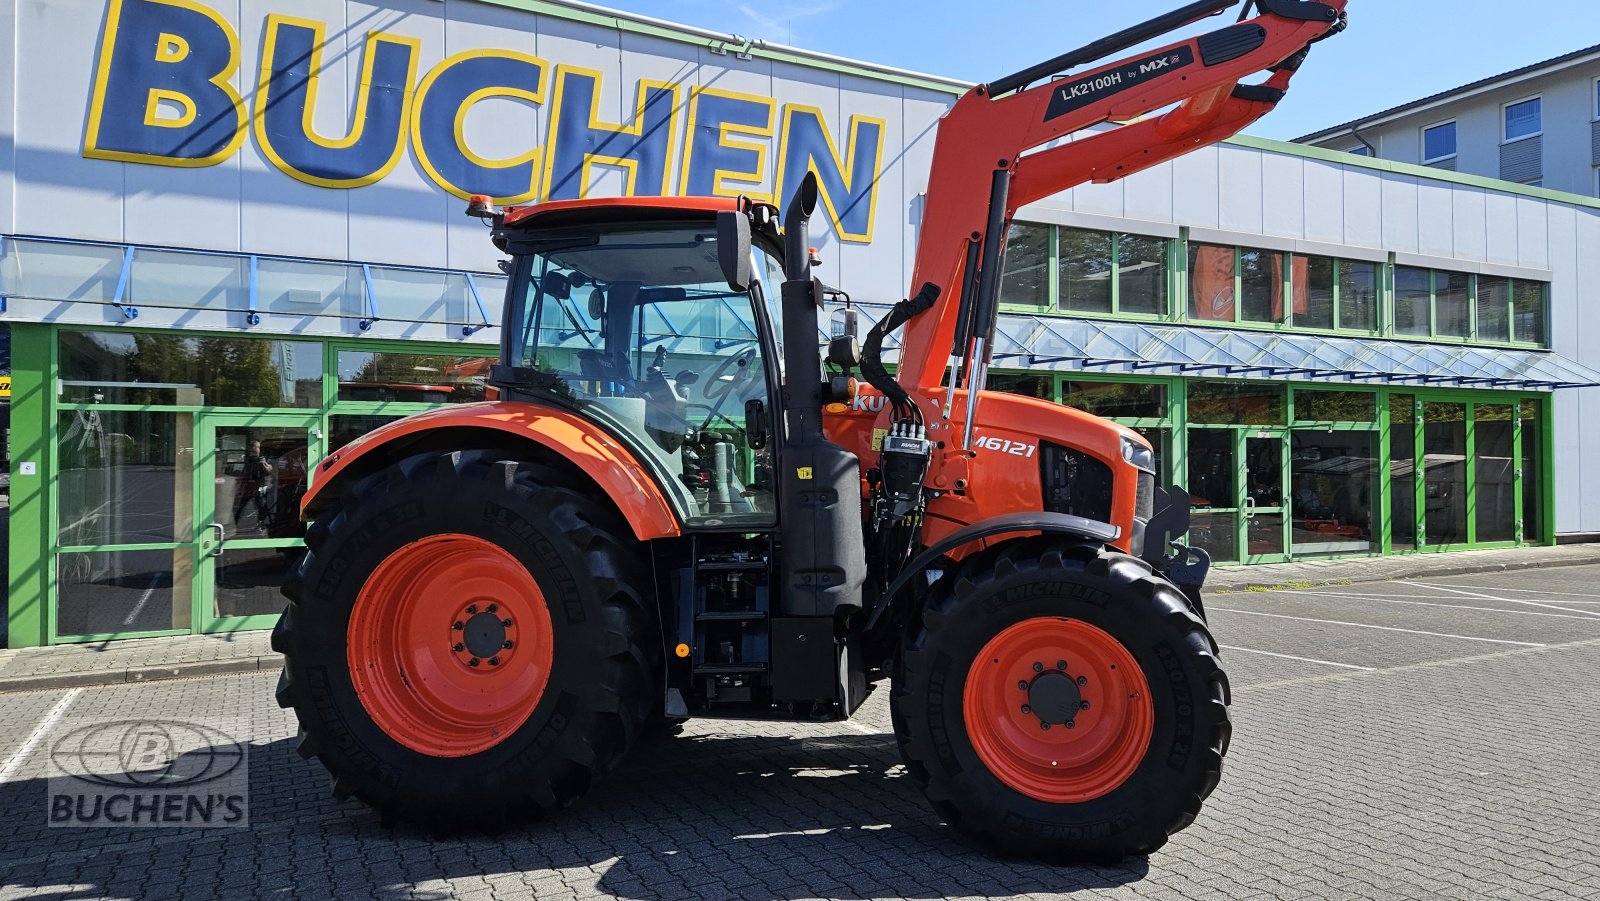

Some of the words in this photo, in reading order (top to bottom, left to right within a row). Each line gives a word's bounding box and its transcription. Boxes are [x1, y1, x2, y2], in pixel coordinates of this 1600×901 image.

[1062, 72, 1122, 101] LK2100H
[1128, 70, 1137, 79] by
[1139, 56, 1170, 75] MX
[83, 0, 886, 243] BUCHEN
[974, 435, 1036, 458] M6121
[510, 517, 586, 621] MICHELIN
[1007, 581, 1112, 609] MICHELIN
